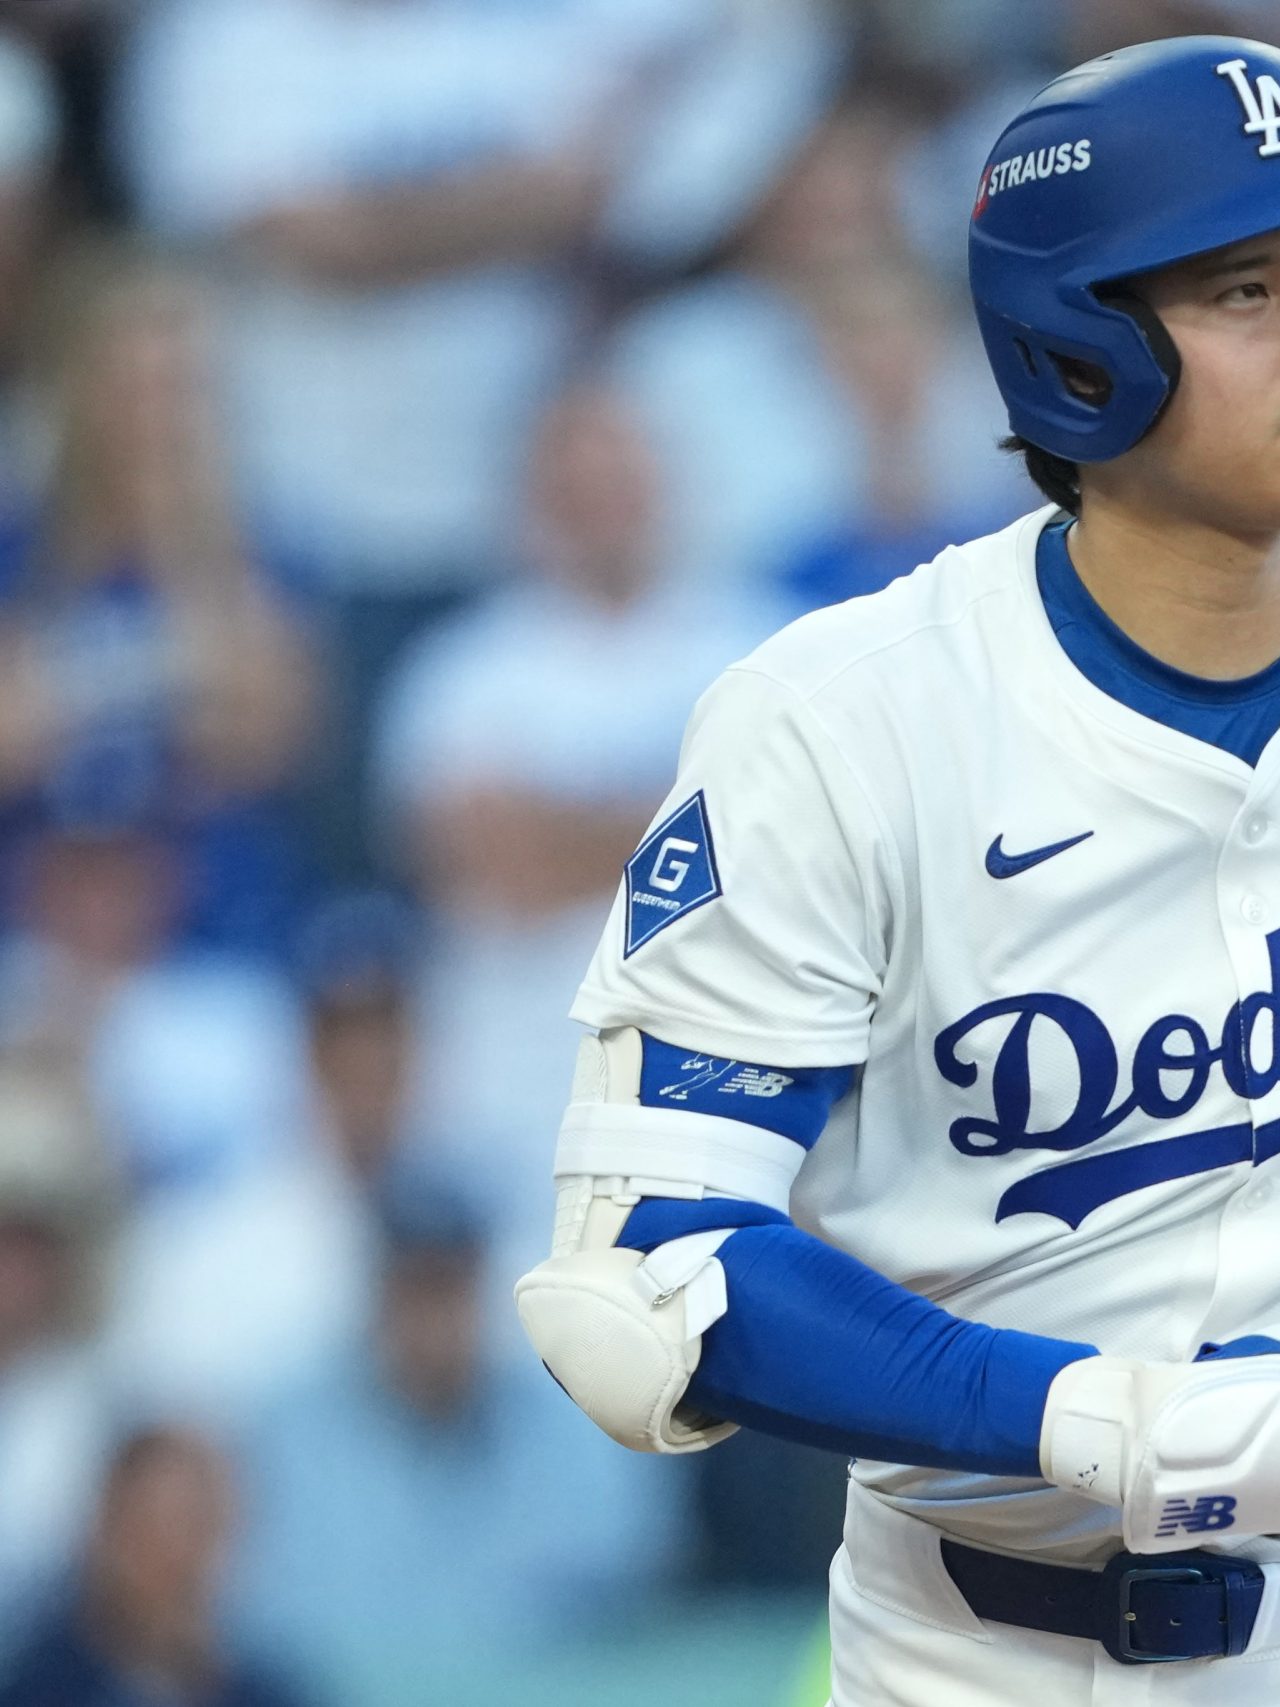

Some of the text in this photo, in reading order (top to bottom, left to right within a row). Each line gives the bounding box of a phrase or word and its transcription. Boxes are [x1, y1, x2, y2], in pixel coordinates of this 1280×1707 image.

[988, 139, 1091, 196] STRAUSS
[648, 836, 699, 892] G
[1154, 1495, 1237, 1538] NB
